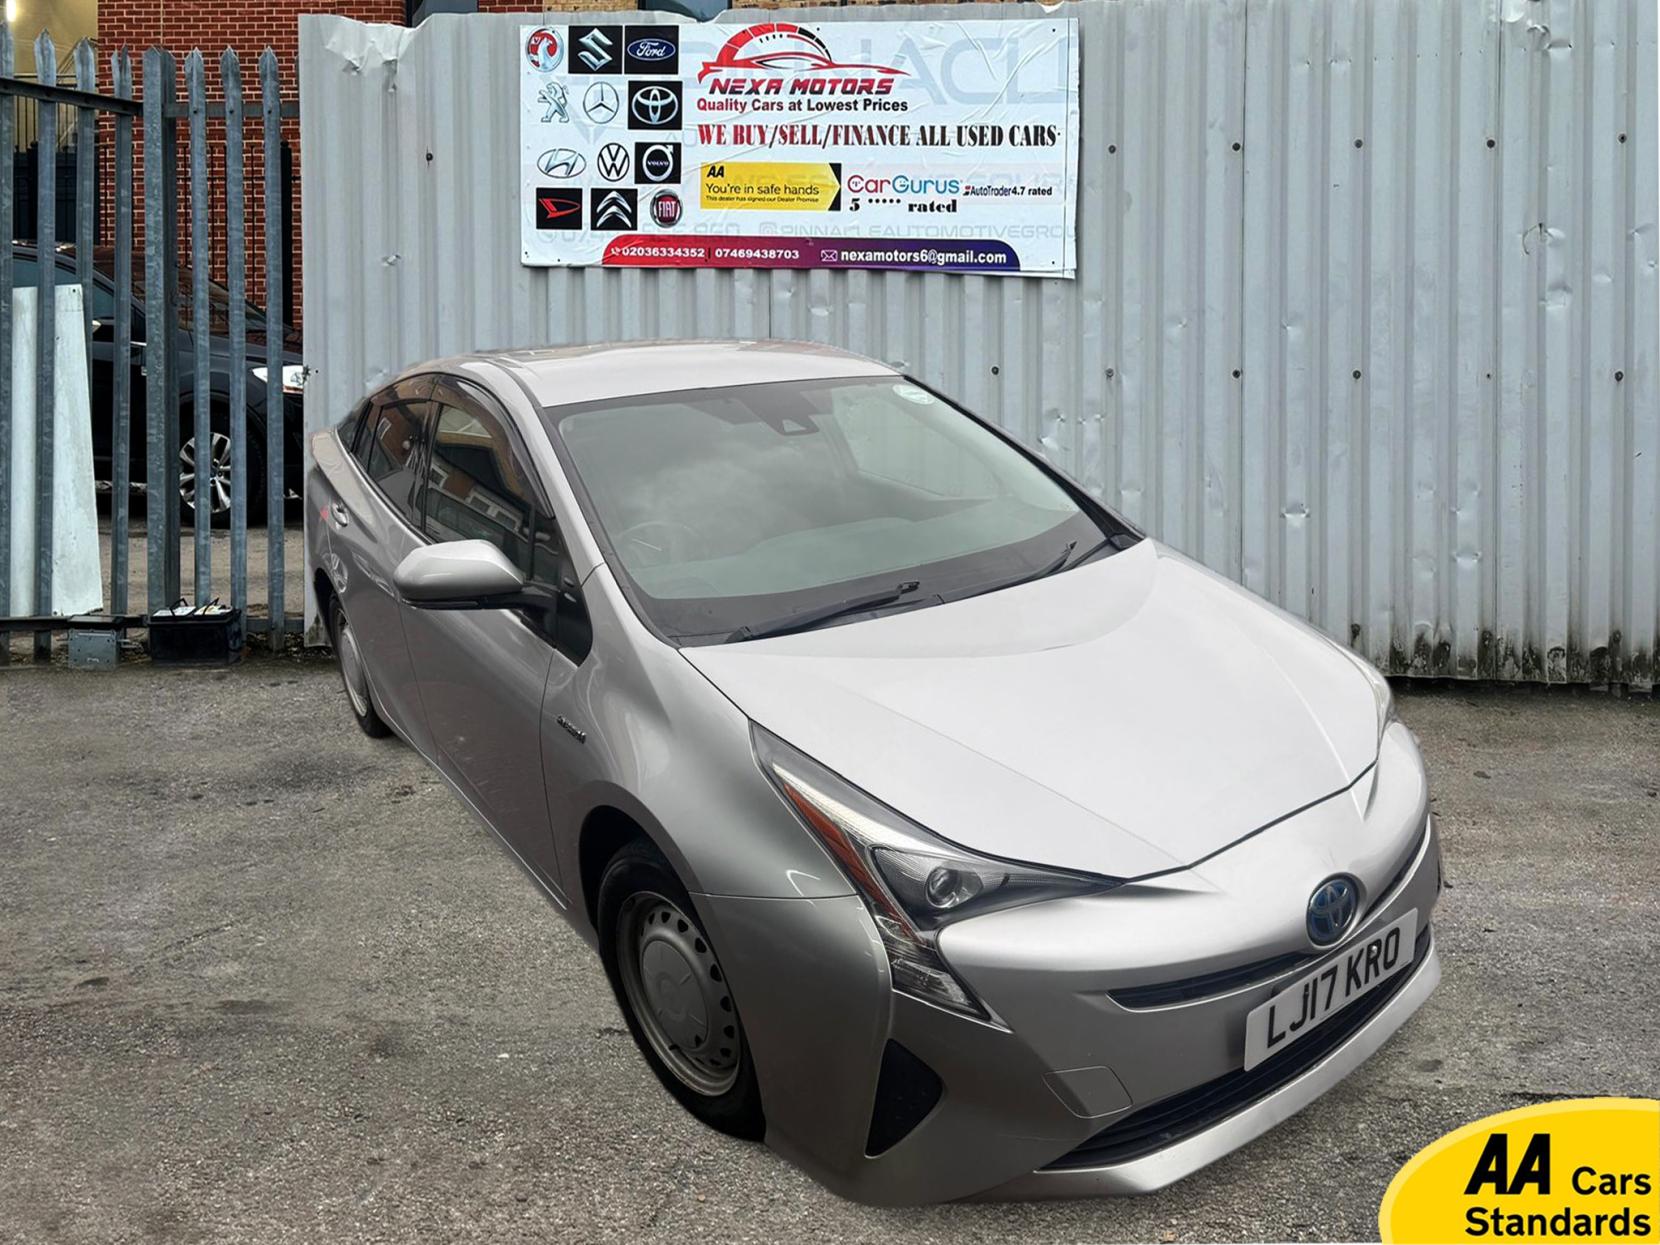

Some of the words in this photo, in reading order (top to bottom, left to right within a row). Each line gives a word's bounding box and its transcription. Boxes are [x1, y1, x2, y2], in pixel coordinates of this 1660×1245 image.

[636, 41, 666, 57] Ford
[709, 78, 781, 96] NEXA
[789, 78, 894, 95] MOTORS
[697, 98, 748, 114] Quality
[751, 98, 784, 112] Cars
[790, 100, 803, 112] at
[807, 98, 858, 112] Lowest
[863, 98, 908, 112] Prices
[698, 126, 727, 145] WE
[733, 125, 910, 148] BUY/SELL/FINANCE
[915, 126, 950, 146] ALL
[956, 126, 1003, 146] USED
[1009, 125, 1056, 147] CARS
[707, 166, 724, 178] AA
[706, 183, 741, 194] You're
[744, 184, 754, 194] in
[757, 184, 781, 194] safe
[784, 184, 820, 195] hands
[847, 174, 960, 194] CarGurus
[1028, 186, 1052, 196] rated
[658, 201, 677, 218] FIAT
[849, 198, 860, 212] 5
[908, 199, 958, 213] rated
[622, 247, 706, 258] 02036334352
[714, 248, 800, 260] 07469438703
[840, 250, 1007, 265] nexamotors6@gmail.com
[1266, 965, 1338, 1049] LJ17
[1345, 926, 1400, 998] KRO
